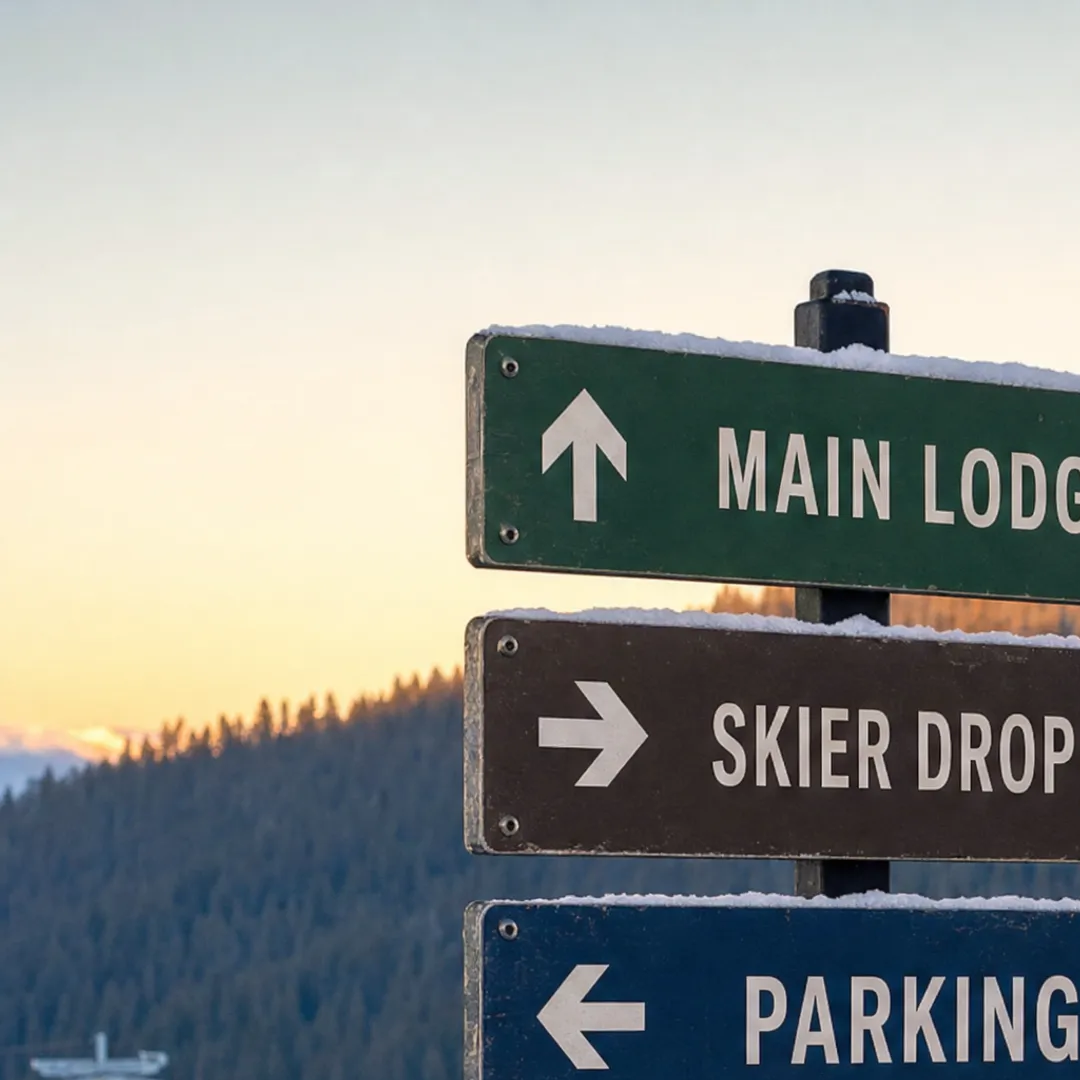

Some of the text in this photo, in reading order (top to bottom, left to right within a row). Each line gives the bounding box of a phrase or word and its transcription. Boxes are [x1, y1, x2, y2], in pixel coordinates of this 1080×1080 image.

[718, 426, 891, 521] MAIN
[712, 702, 892, 790] SKIER
[746, 975, 1079, 1065] PARKING
